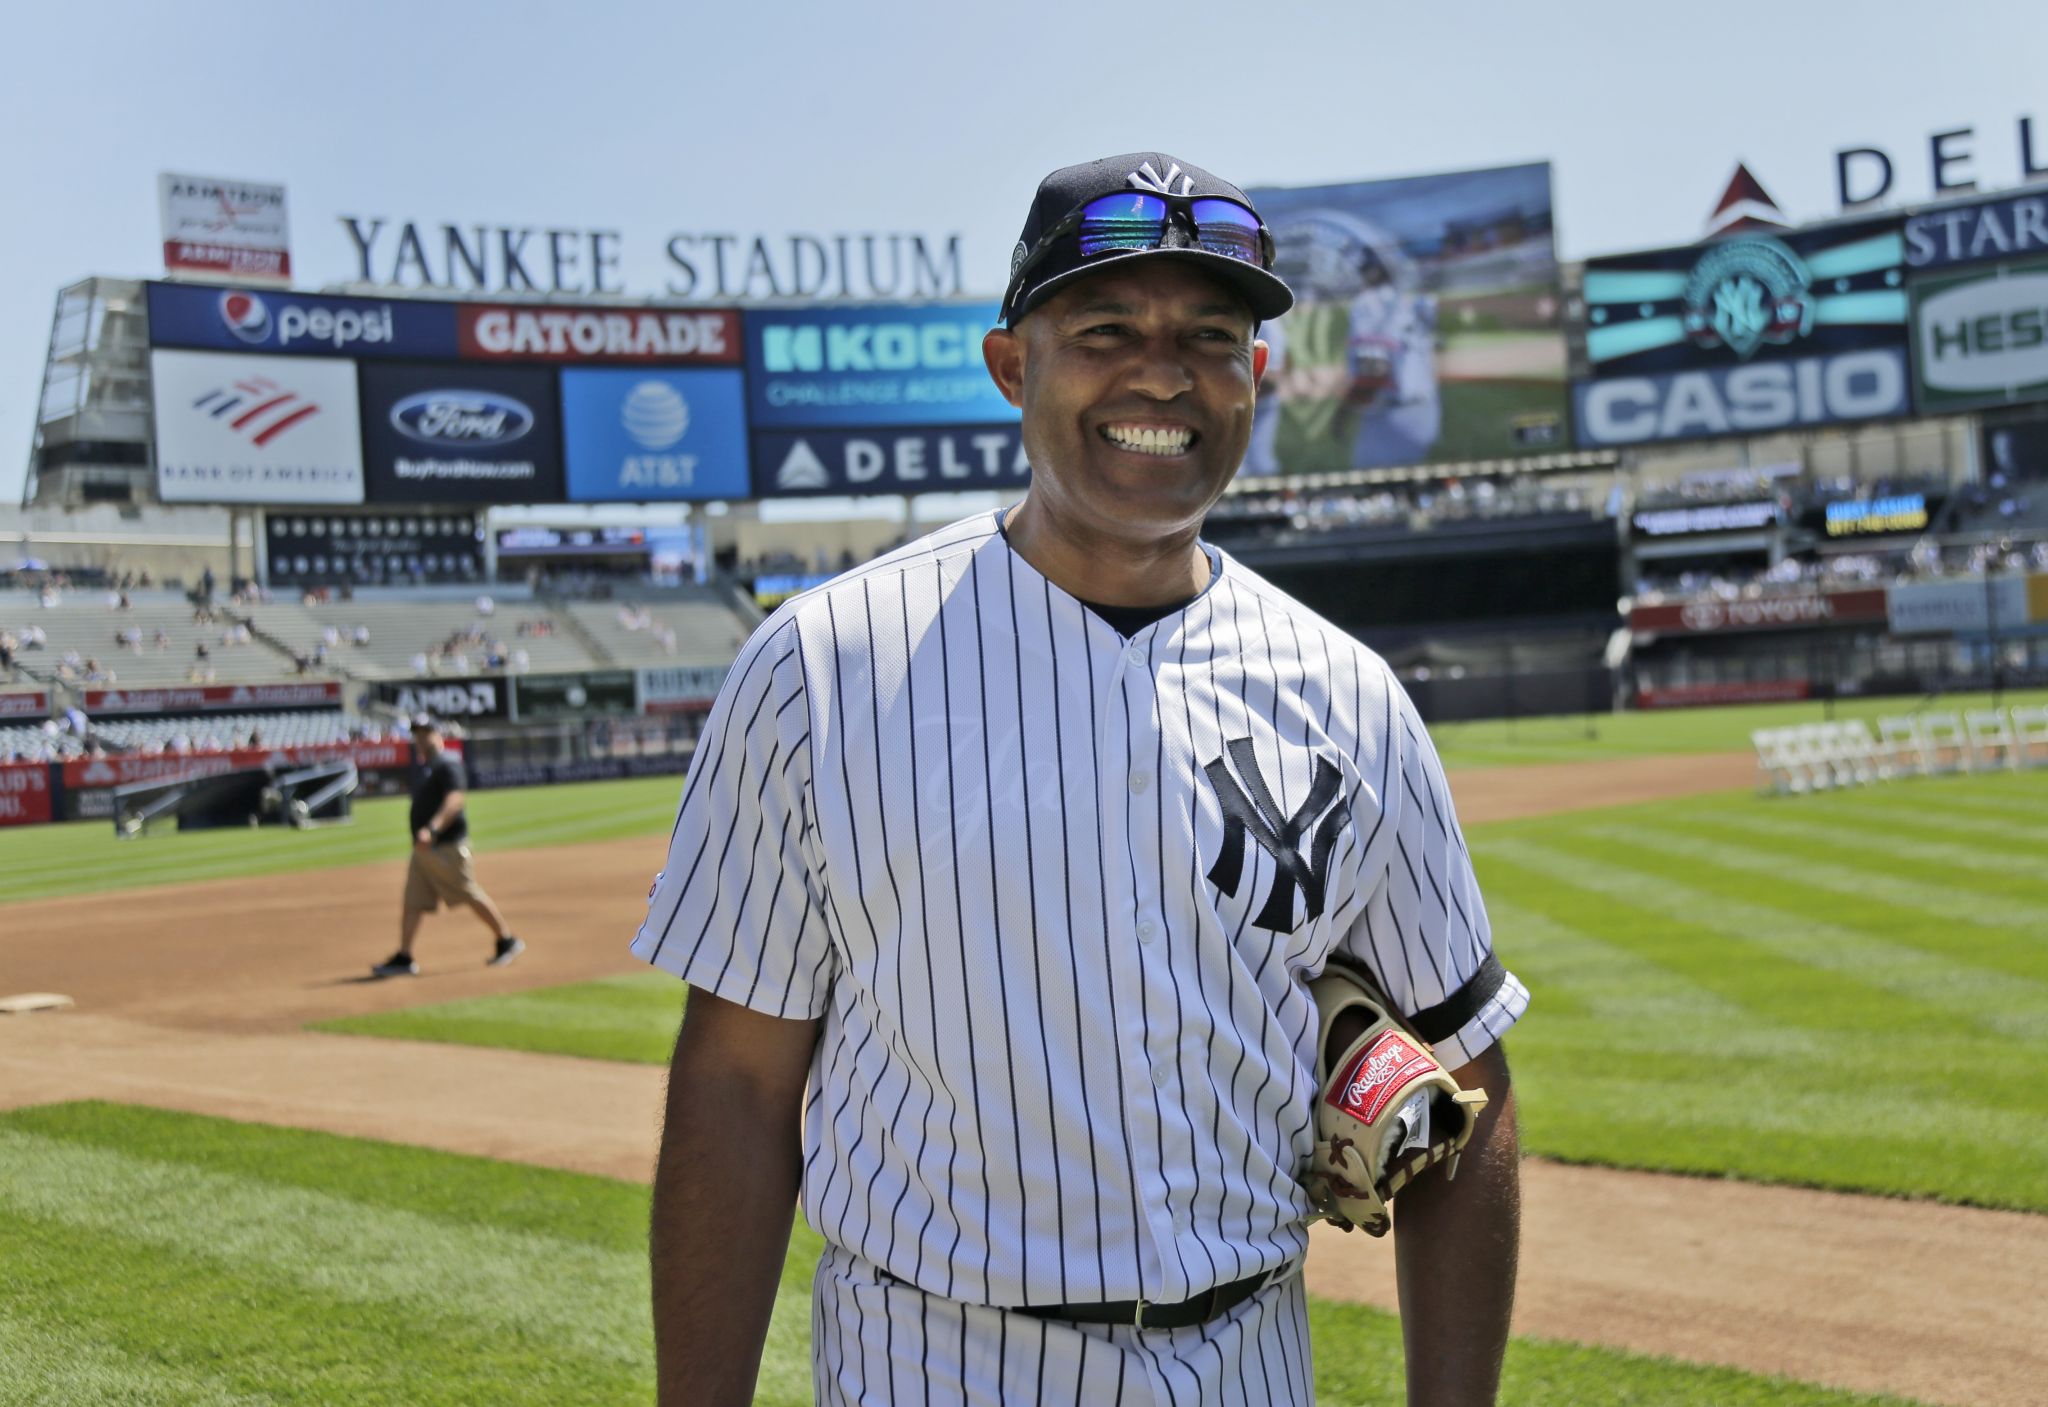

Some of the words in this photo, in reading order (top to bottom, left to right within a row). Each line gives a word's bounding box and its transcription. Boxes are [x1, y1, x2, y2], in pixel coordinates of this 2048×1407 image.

[337, 216, 624, 296] YANKEE
[666, 233, 962, 298] STADIUM
[277, 305, 393, 348] pepsi
[474, 310, 726, 355] GATORADE
[1582, 351, 1905, 443] CASIO
[418, 399, 508, 440] Ford
[163, 464, 223, 482] BANK
[231, 465, 254, 482] OF
[263, 466, 355, 486] AMERICA
[618, 454, 696, 488] AT&T
[396, 684, 469, 717] AMD
[1348, 1043, 1404, 1107] Rawlings
